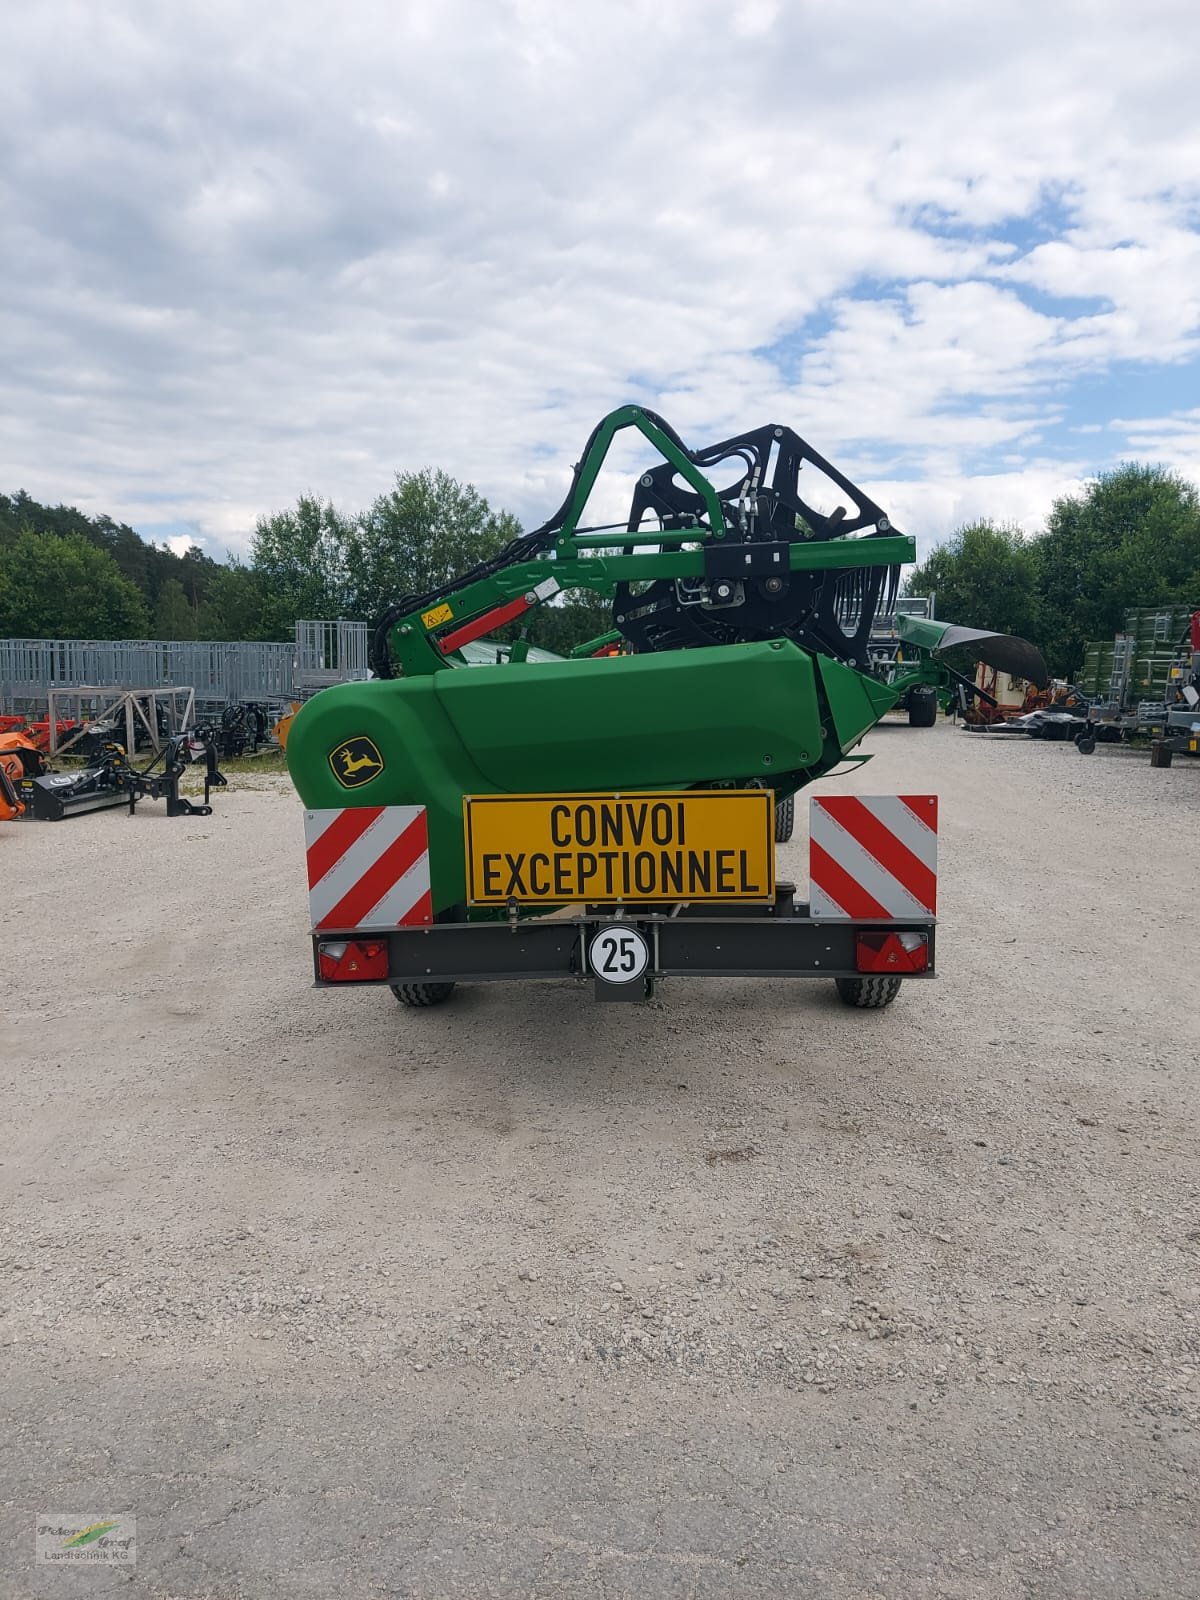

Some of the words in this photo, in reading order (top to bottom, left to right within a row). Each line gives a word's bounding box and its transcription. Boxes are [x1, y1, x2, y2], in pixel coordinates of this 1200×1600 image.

[551, 803, 685, 847] CONVOI
[482, 850, 760, 896] EXCEPTIONNEL
[602, 938, 635, 972] 25
